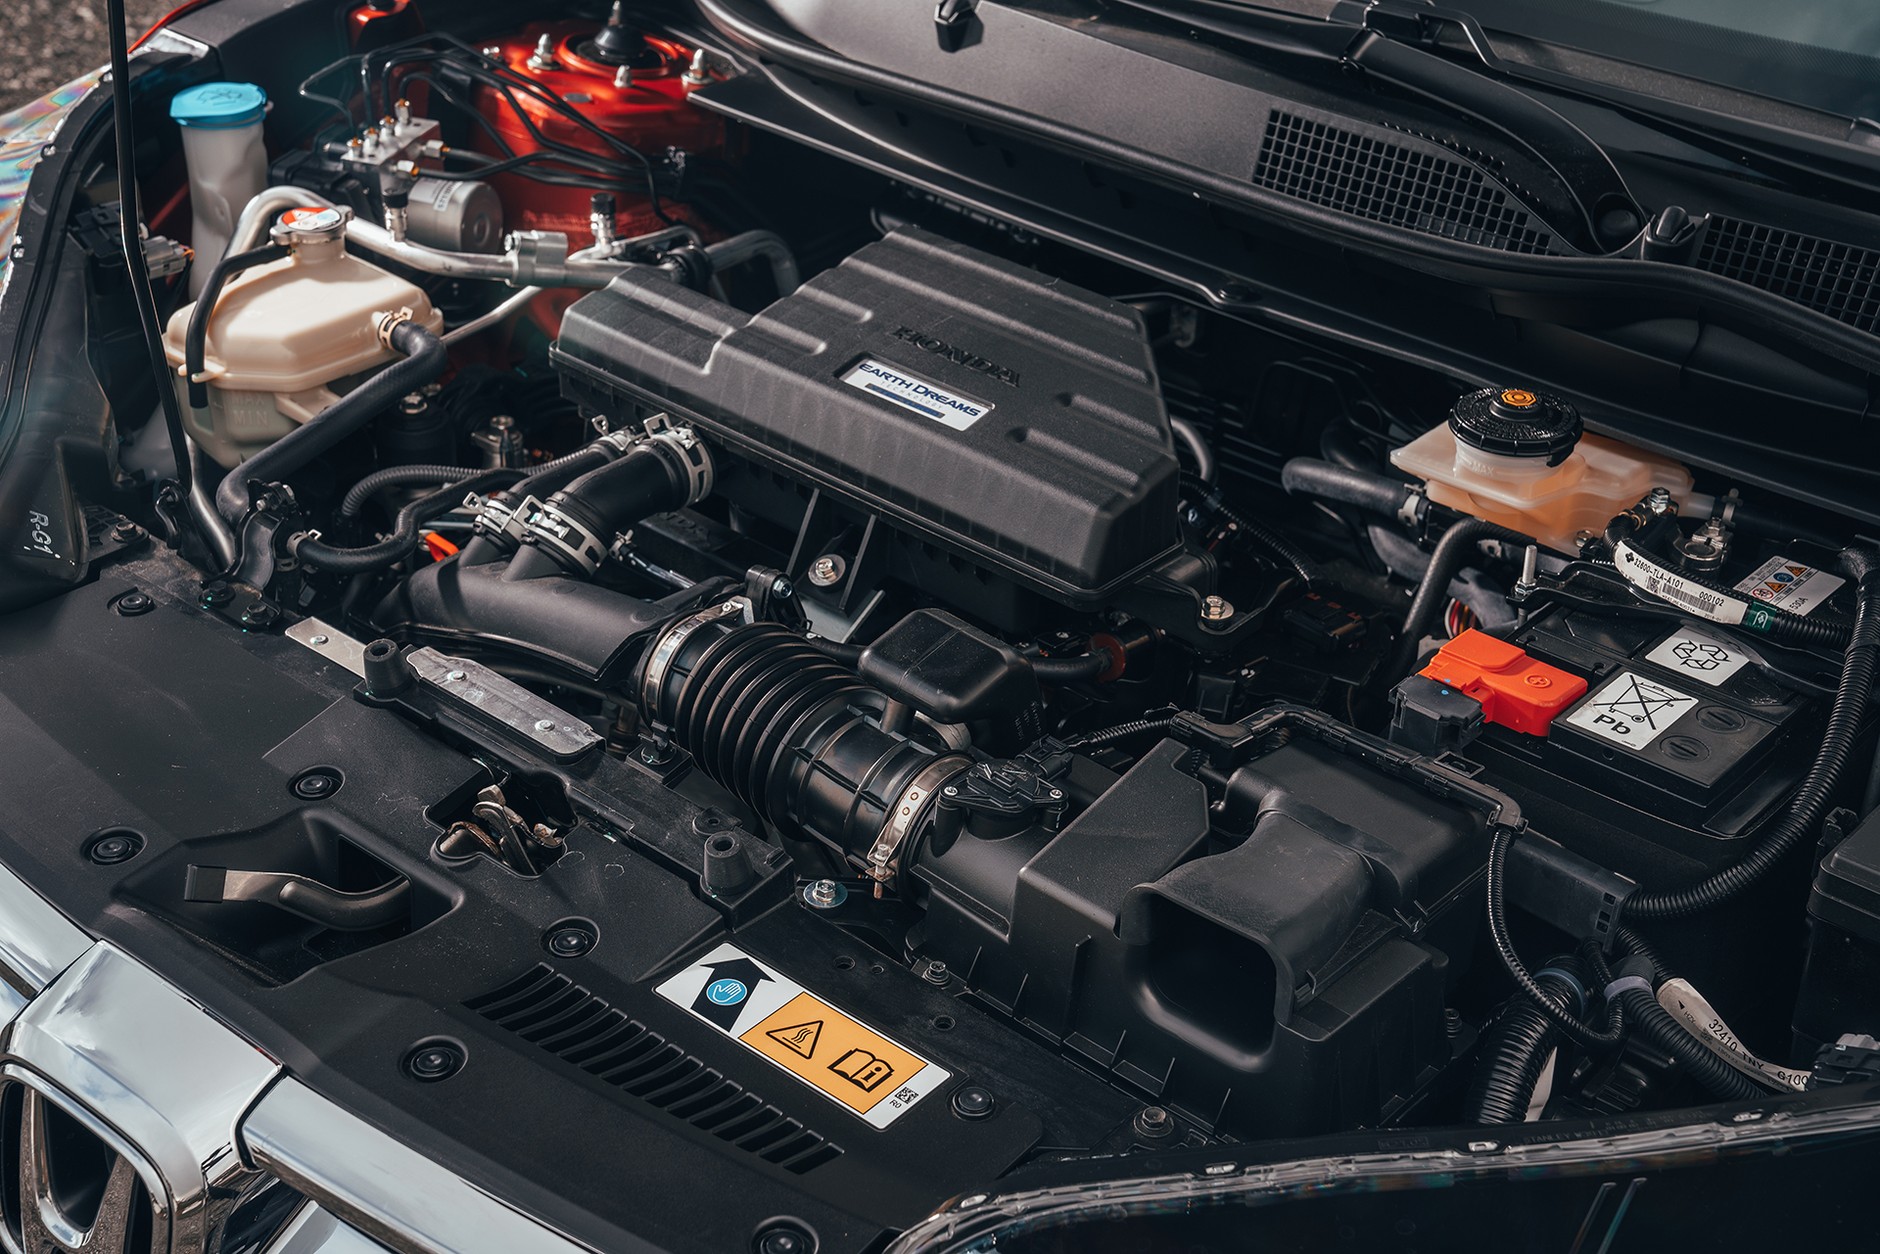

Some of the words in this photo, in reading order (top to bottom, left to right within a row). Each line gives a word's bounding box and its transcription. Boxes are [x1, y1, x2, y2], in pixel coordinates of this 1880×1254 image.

[892, 325, 1020, 388] HONDA
[858, 363, 912, 389] EARTH
[912, 384, 981, 417] DREAMS
[880, 380, 943, 409] TECHNOLOGY
[232, 408, 268, 426] MIN
[1471, 460, 1495, 476] MAX
[1698, 591, 1725, 607] 000102
[1592, 713, 1631, 735] Pb
[1708, 1018, 1738, 1052] 32410
[1741, 1052, 1764, 1070] TNY
